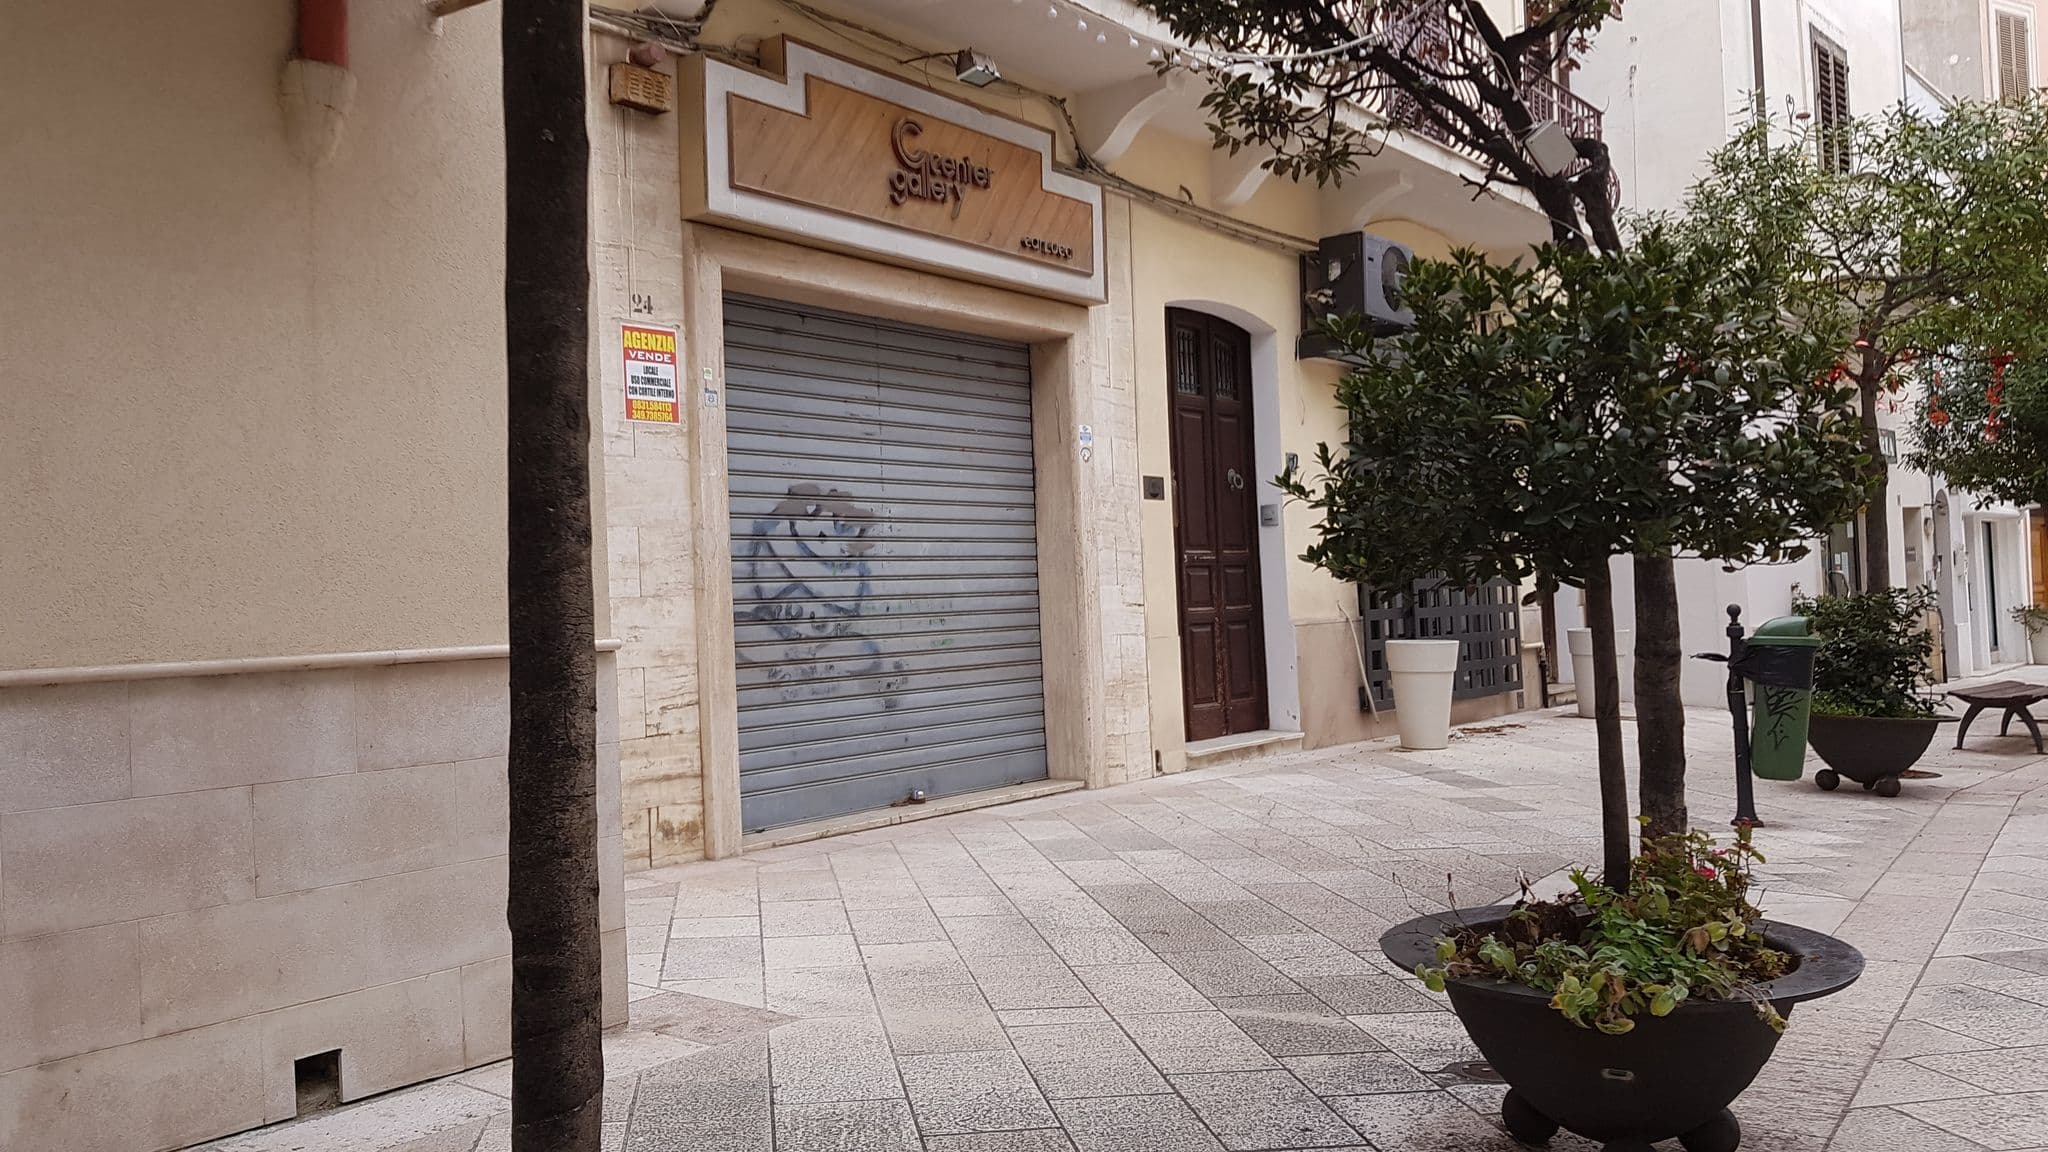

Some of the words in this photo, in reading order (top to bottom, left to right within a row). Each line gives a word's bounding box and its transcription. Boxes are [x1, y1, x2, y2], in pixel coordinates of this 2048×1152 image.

[632, 294, 653, 315] 24
[623, 330, 675, 353] AGENZIA
[629, 350, 672, 363] VENDE
[643, 365, 659, 376] LOCALE
[630, 375, 640, 385] USO
[641, 376, 671, 388] COMMERCIALE
[628, 386, 638, 396] CON
[639, 387, 656, 397] CORTILE
[657, 388, 675, 399] INTERNO
